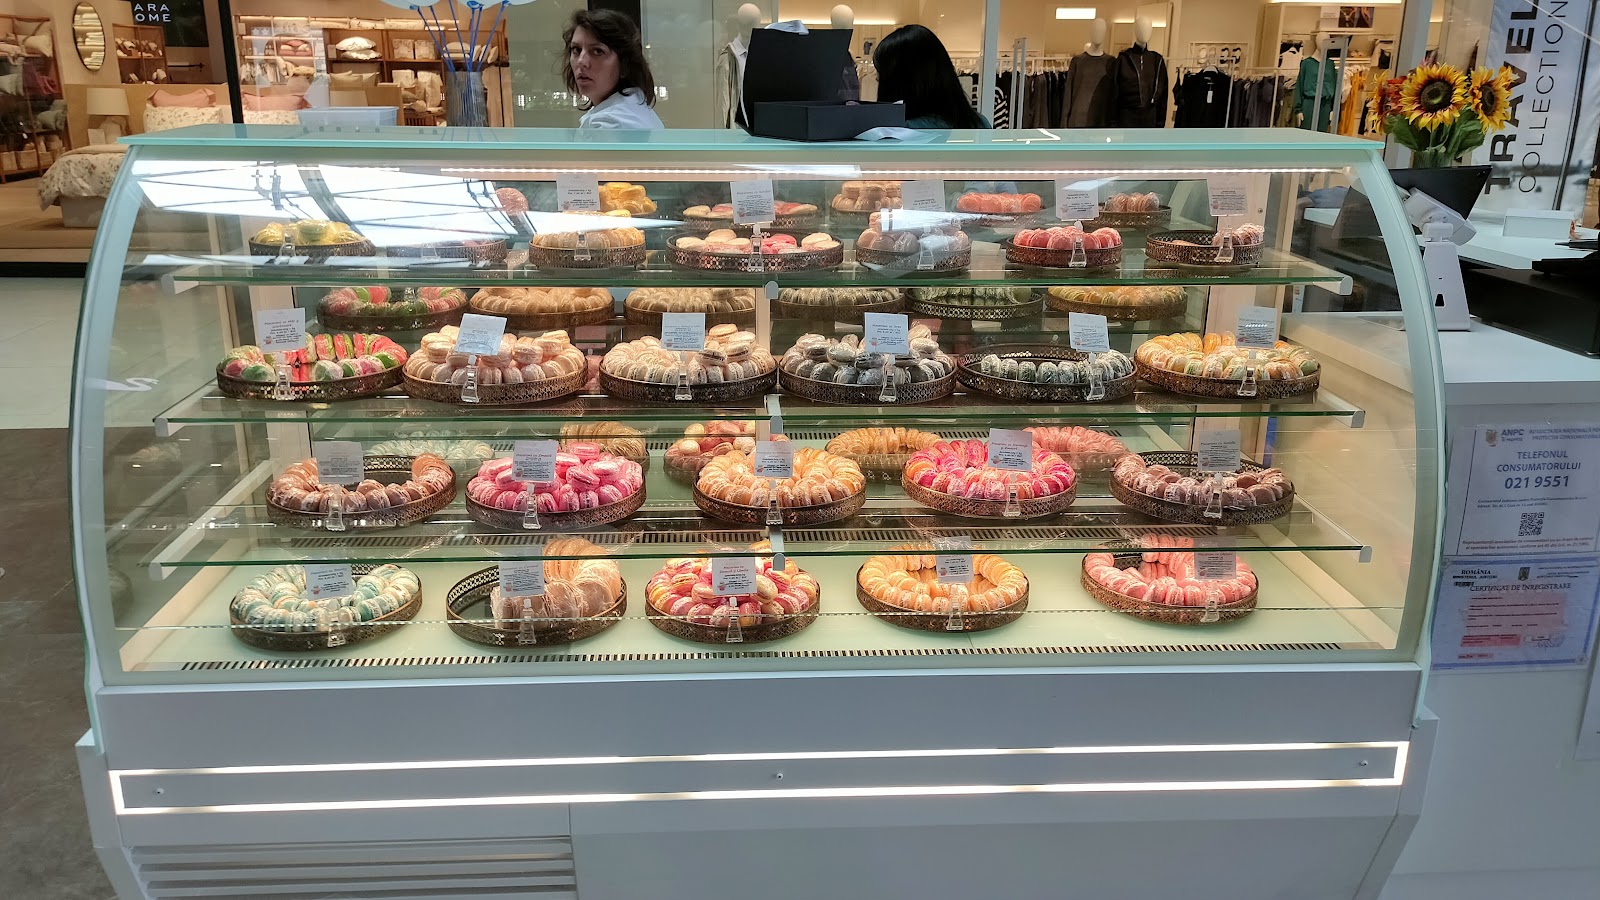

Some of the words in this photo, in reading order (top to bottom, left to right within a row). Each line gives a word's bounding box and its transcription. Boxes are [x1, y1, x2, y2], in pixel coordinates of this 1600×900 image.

[1484, 0, 1540, 195] TRAVEL
[1518, 0, 1569, 194] COLLECTION
[1501, 428, 1524, 436] ANPC
[1517, 450, 1568, 459] TELEFONUL
[1497, 462, 1581, 472] CONSUMATORULUI
[1504, 477, 1530, 489] 021
[1534, 475, 1569, 488] 9551
